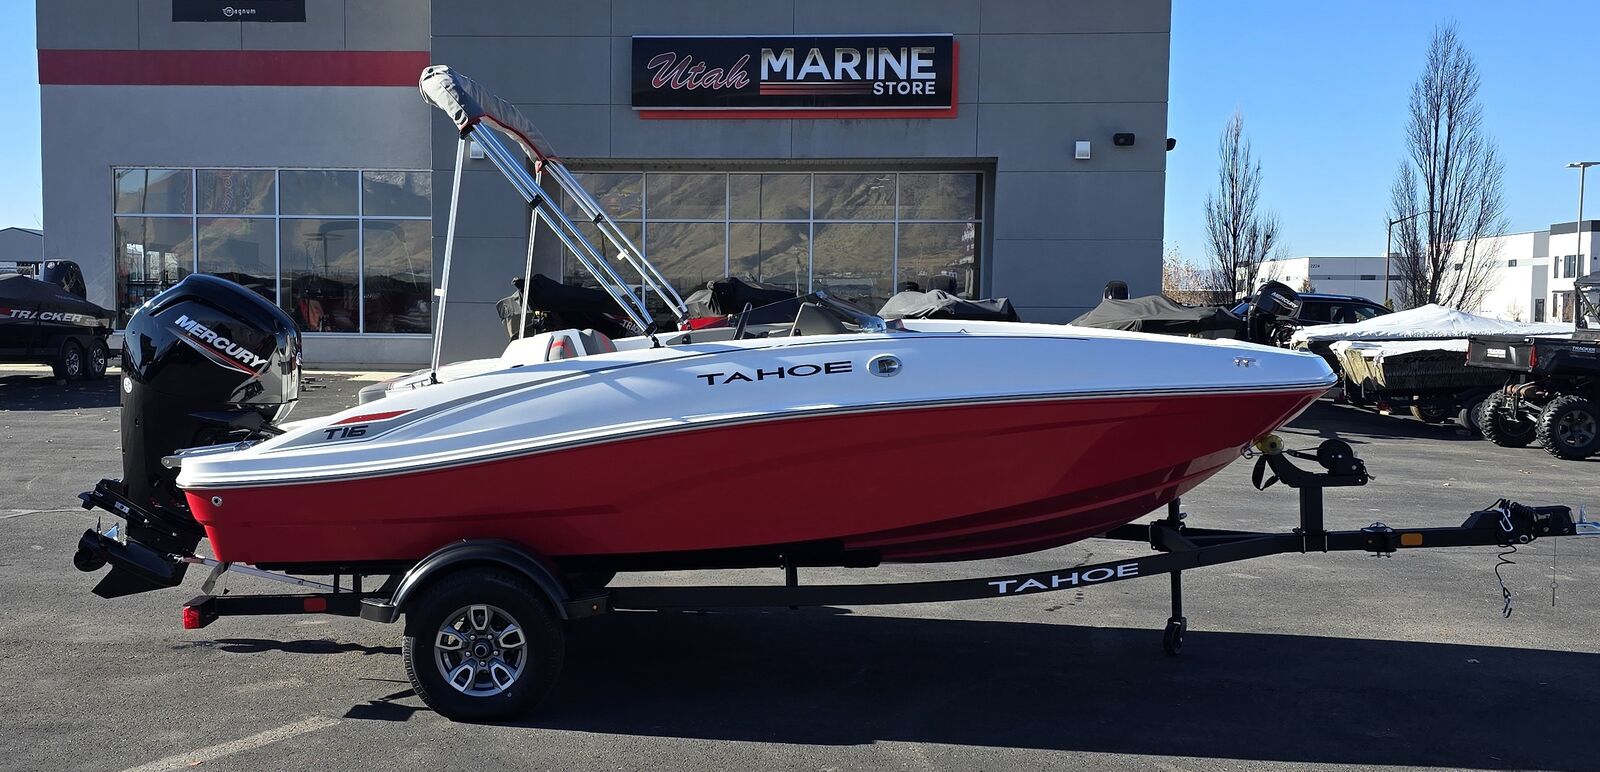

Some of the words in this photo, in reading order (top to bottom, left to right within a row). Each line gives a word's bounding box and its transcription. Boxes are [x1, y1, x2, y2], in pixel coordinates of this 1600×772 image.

[647, 51, 750, 90] Utah
[759, 46, 937, 80] MARINE
[873, 81, 936, 95] STORE
[10, 309, 83, 323] TRACKER
[174, 314, 269, 368] MERCURY
[696, 360, 853, 386] TAHOE
[323, 424, 369, 440] T16
[988, 562, 1139, 594] TAHOE
